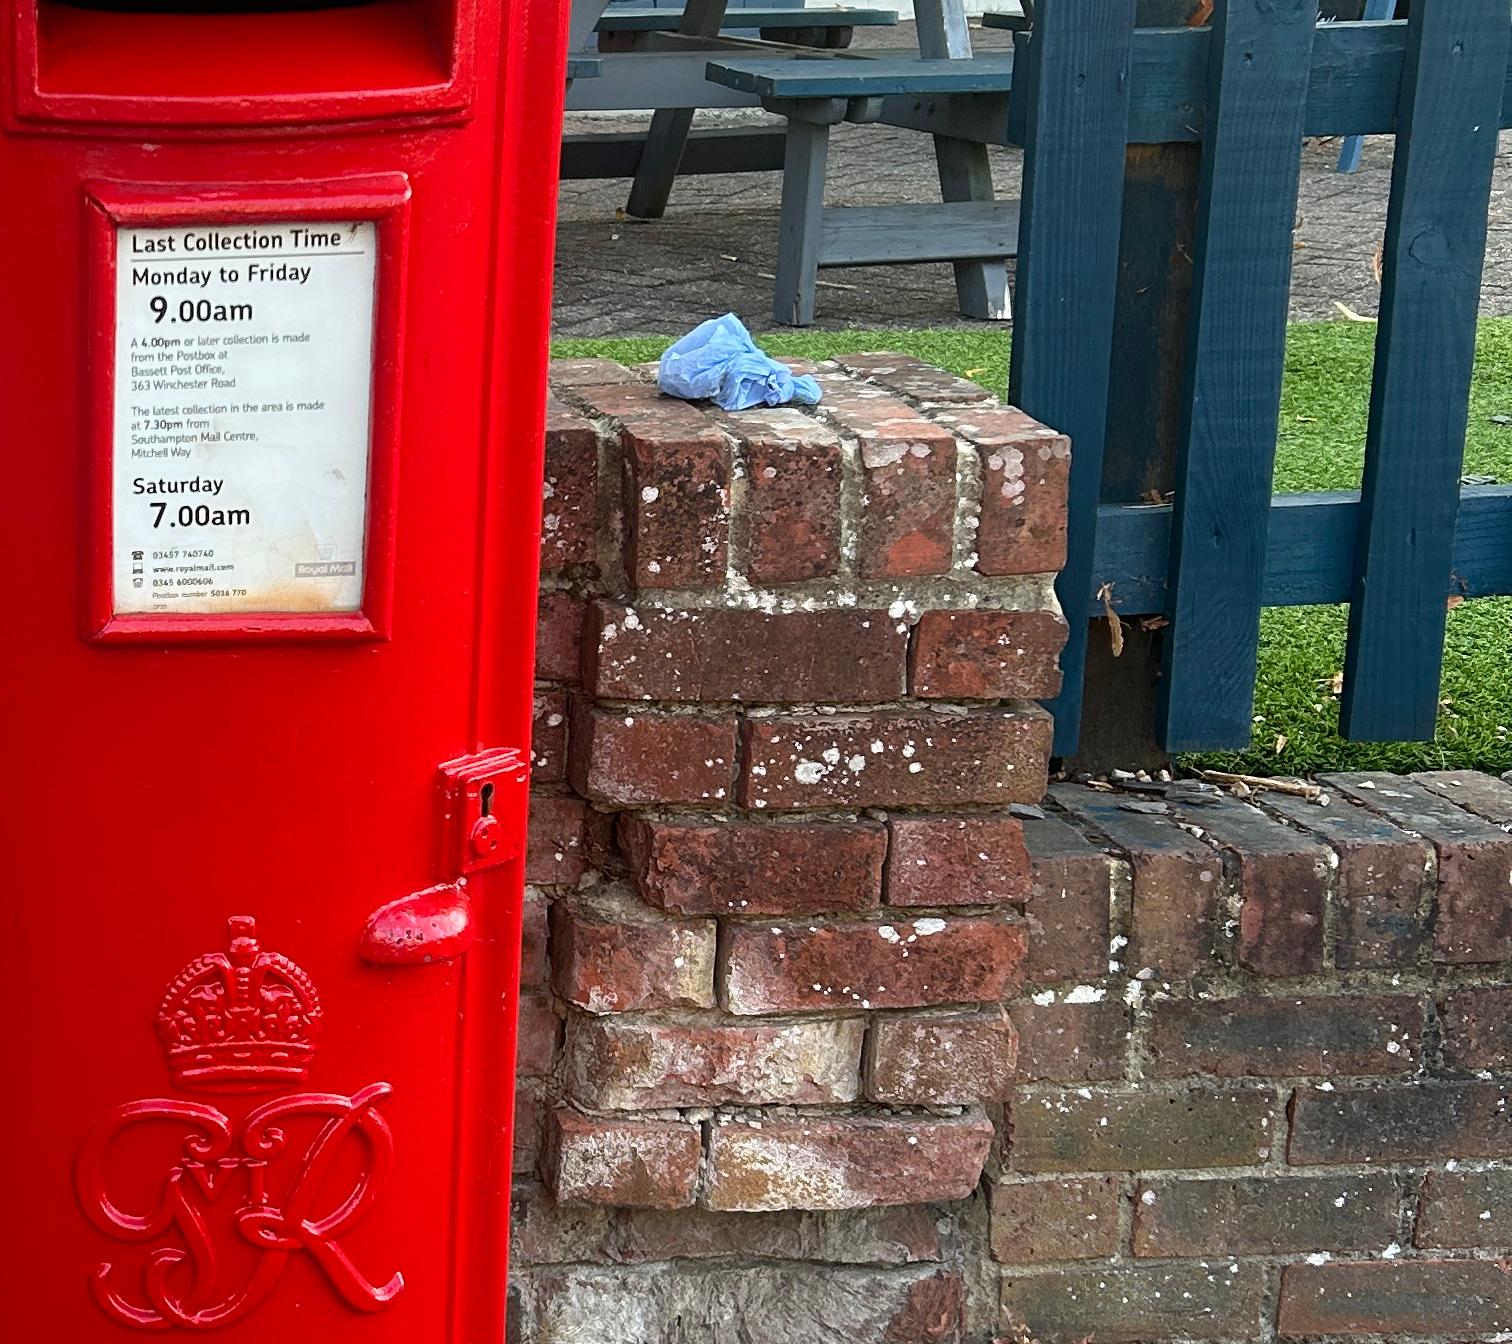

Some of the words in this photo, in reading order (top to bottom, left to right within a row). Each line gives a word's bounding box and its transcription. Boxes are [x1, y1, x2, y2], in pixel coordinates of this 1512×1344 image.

[131, 234, 176, 253] Last
[183, 230, 283, 252] Collection
[290, 228, 341, 248] Time
[132, 267, 211, 288] Monday
[219, 267, 239, 283] to
[248, 263, 311, 285] Friday
[149, 296, 253, 324] 9.00am
[131, 339, 138, 348] A
[141, 337, 181, 349] 4.00pm
[184, 339, 194, 347] or
[197, 336, 219, 346] later
[222, 334, 269, 346] collection
[272, 333, 279, 344] is
[283, 332, 310, 344] made
[131, 352, 154, 362] from
[158, 351, 173, 362] the
[177, 350, 216, 361] Postbox
[218, 350, 228, 360] at
[131, 366, 167, 377] Bassett
[171, 365, 192, 376] Post
[131, 380, 150, 391] 363
[153, 379, 207, 390] Winchester
[211, 378, 236, 388] Road
[131, 406, 149, 416] The
[153, 405, 179, 416] latest
[182, 403, 227, 415] collection
[231, 403, 239, 413] in
[243, 403, 258, 413] the
[262, 403, 283, 412] area
[286, 401, 293, 411] is
[297, 400, 325, 411] made
[131, 421, 141, 431] at
[143, 420, 183, 433] 7.30pm
[186, 418, 209, 429] from
[131, 433, 198, 445] Southampton
[201, 432, 221, 442] Mail
[131, 447, 168, 459] Mitchell
[170, 447, 192, 459] Way
[133, 476, 224, 496] Saturday
[149, 502, 251, 529] 7.00am
[298, 565, 328, 575] Royal
